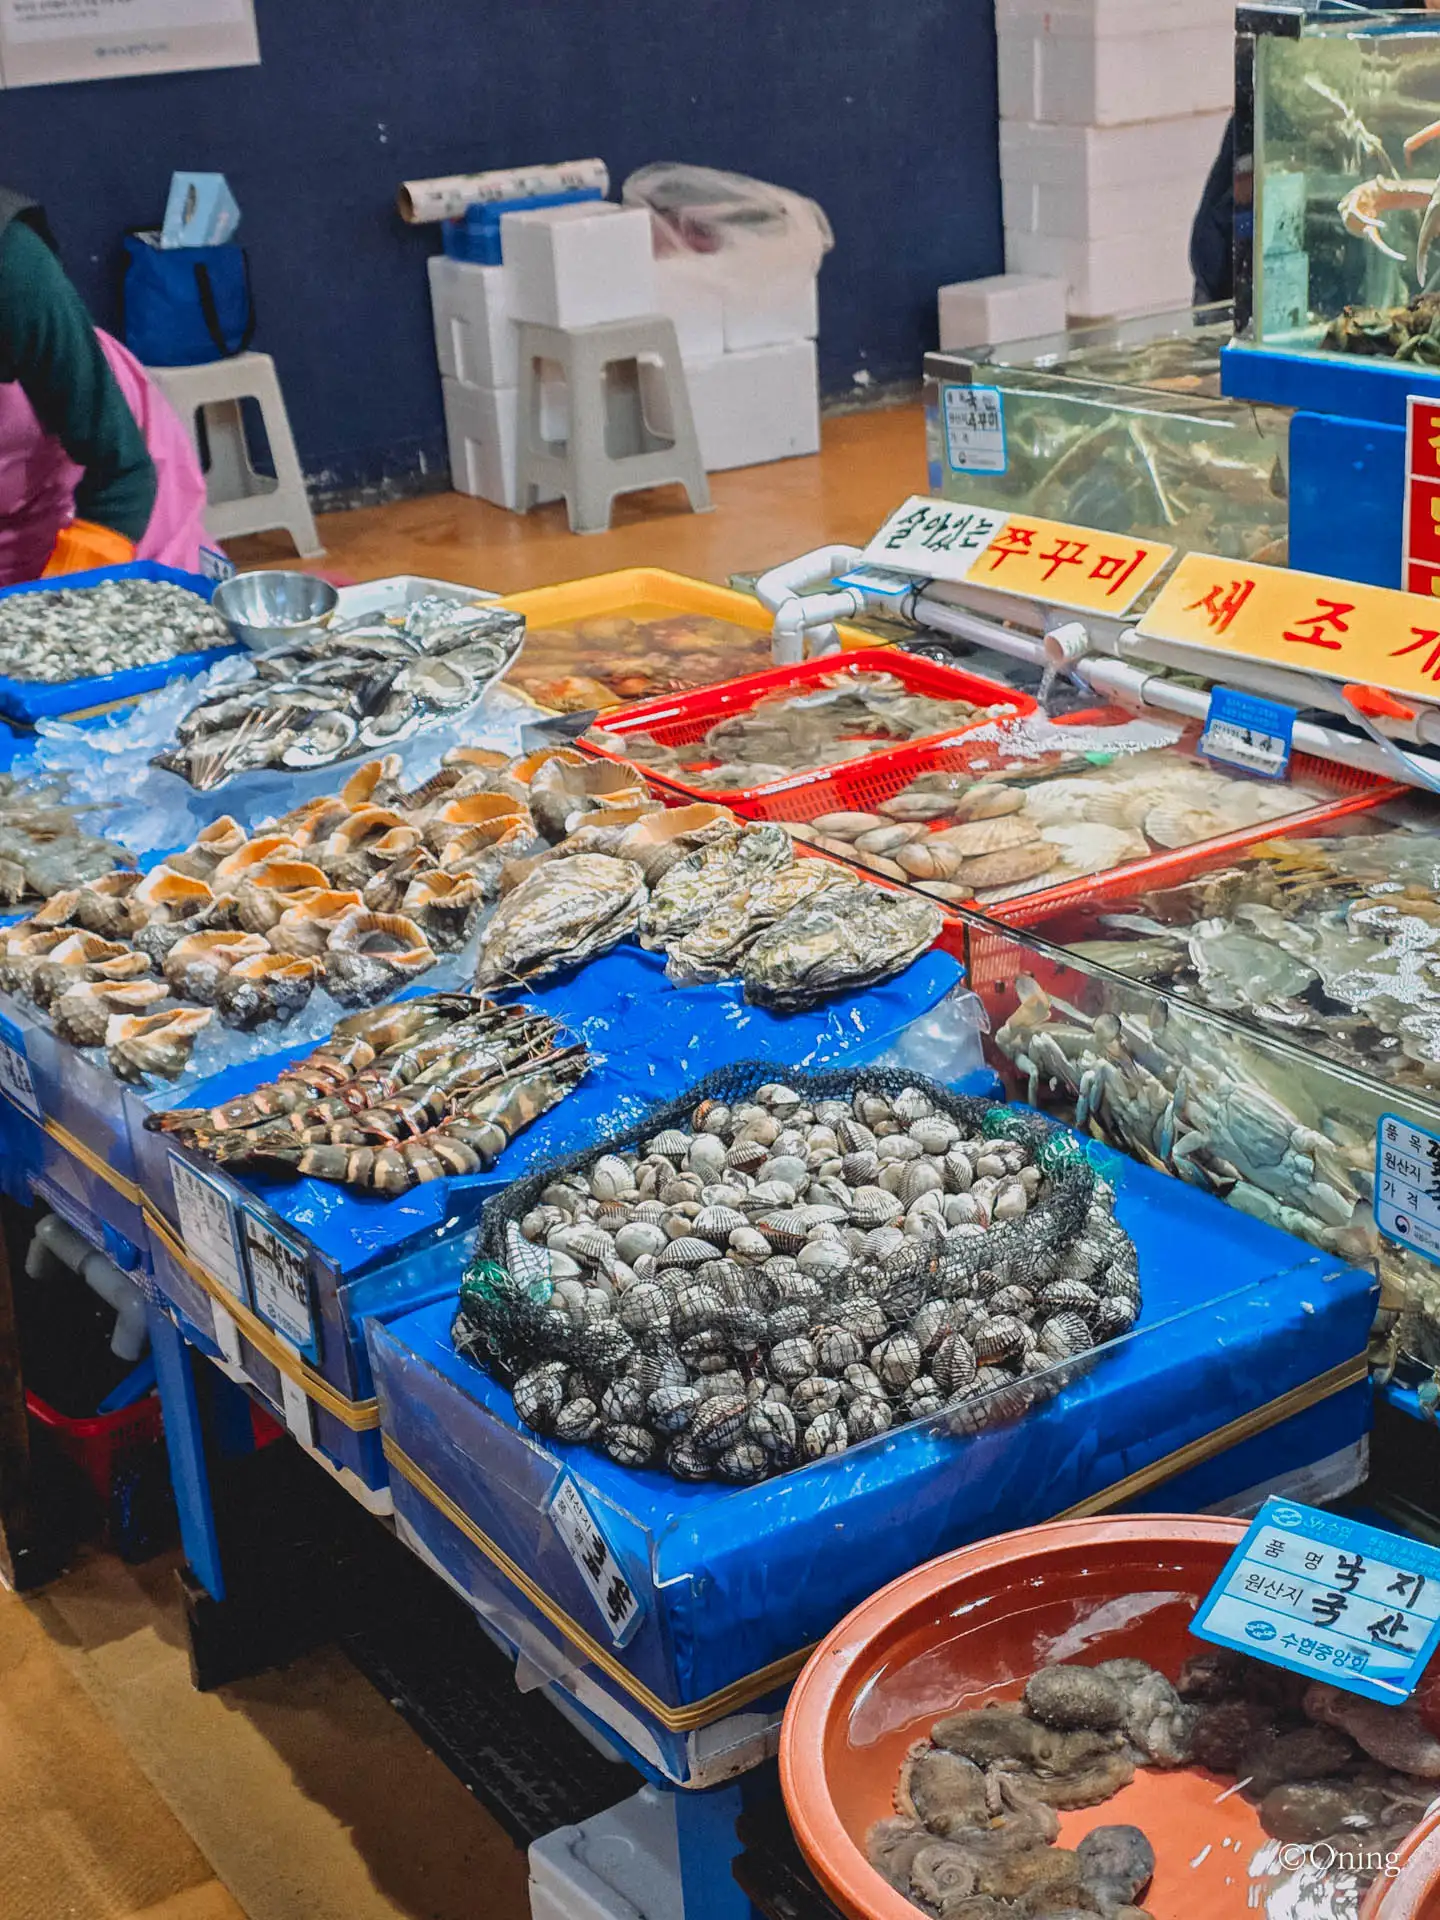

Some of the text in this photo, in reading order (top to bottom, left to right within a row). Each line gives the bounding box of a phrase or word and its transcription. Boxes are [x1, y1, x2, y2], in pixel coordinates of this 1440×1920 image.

[885, 506, 1147, 596] 살아있는 쭈꾸미
[1384, 1151, 1421, 1183] 원산지
[565, 1484, 591, 1532] 원산지
[1245, 1573, 1304, 1607] 원산지
[1280, 1632, 1370, 1673] 수협중앙회
